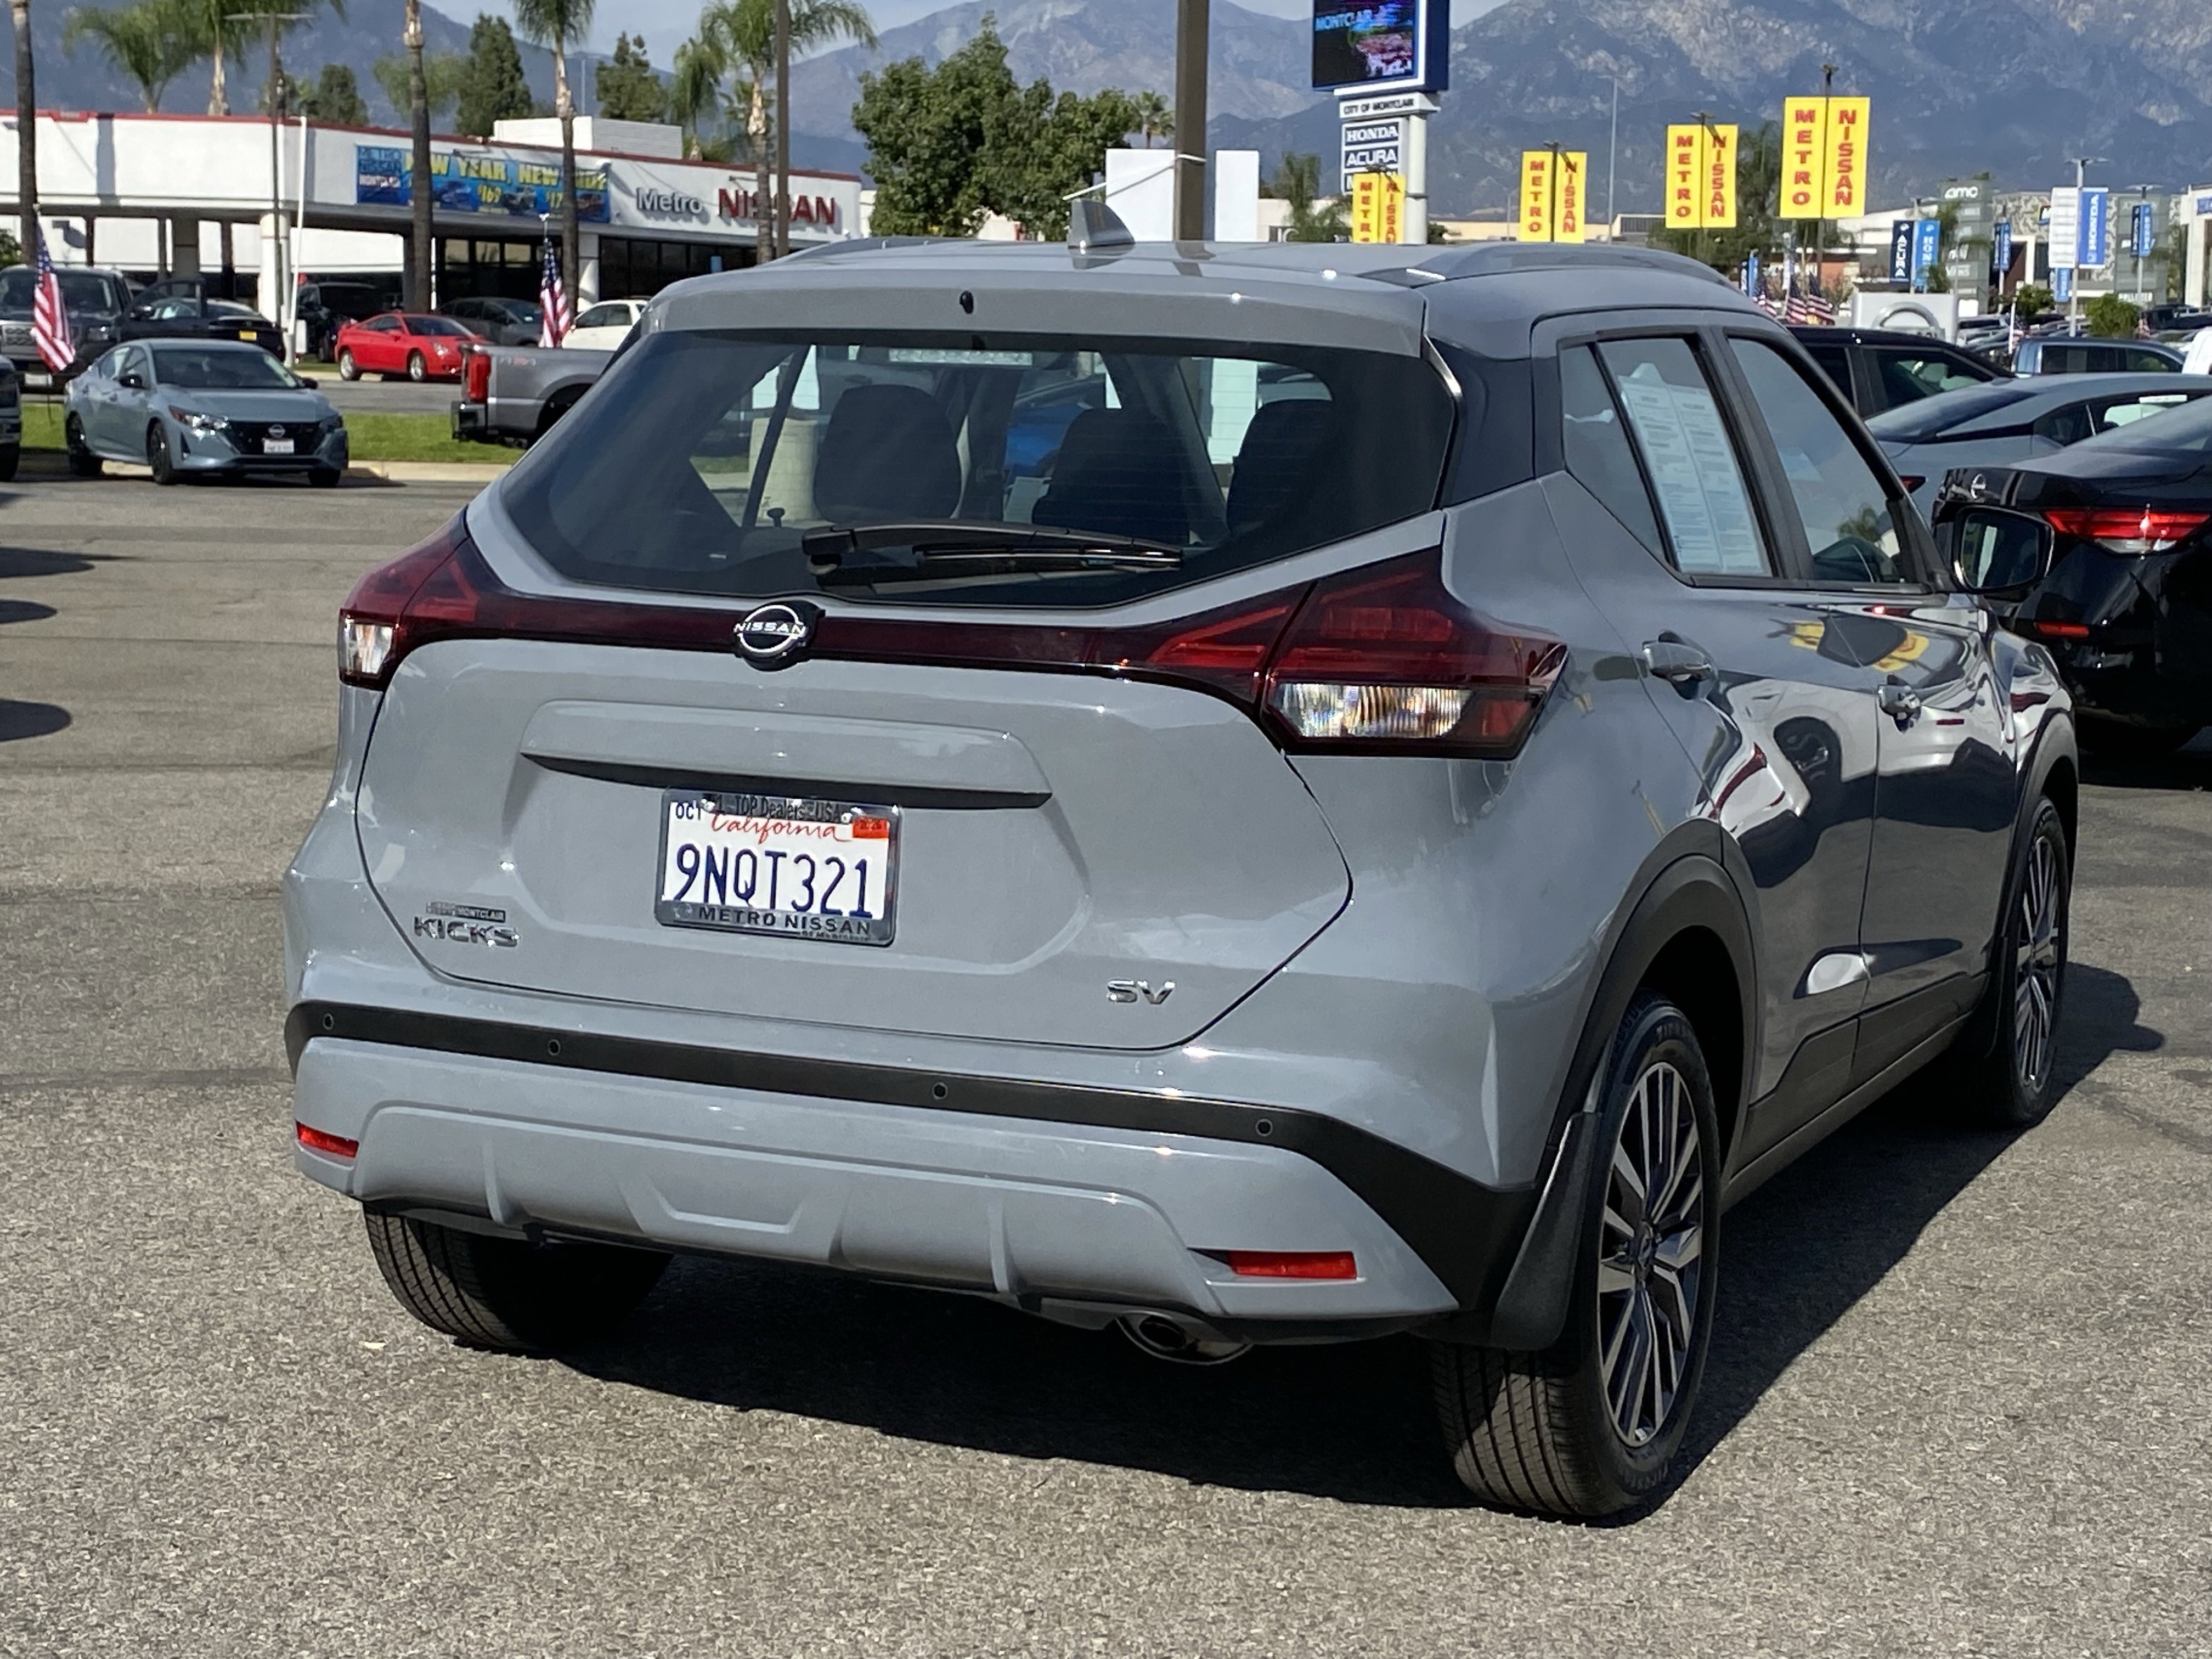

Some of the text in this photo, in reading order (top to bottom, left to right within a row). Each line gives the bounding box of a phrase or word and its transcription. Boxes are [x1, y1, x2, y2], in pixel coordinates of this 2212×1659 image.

[1344, 105, 1358, 114] CITY
[1361, 103, 1369, 111] OF
[1347, 125, 1398, 142] HONDA
[1346, 149, 1397, 166] ACURA
[1792, 109, 1815, 205] METRO
[1834, 110, 1857, 206] NISSAN
[518, 164, 558, 185] NEW
[1676, 135, 1694, 217] METRO
[1711, 136, 1727, 218] NISSAN
[636, 188, 835, 224] Metro NIAN
[1528, 160, 1544, 232] METRO
[1895, 234, 1907, 276] ACURA
[733, 622, 806, 637] NISSAN
[712, 814, 852, 844] California
[674, 843, 873, 919] 9NQT321
[414, 916, 519, 947] KICKS
[698, 906, 870, 936] METRO NISSAN
[1107, 978, 1176, 1005] SV
